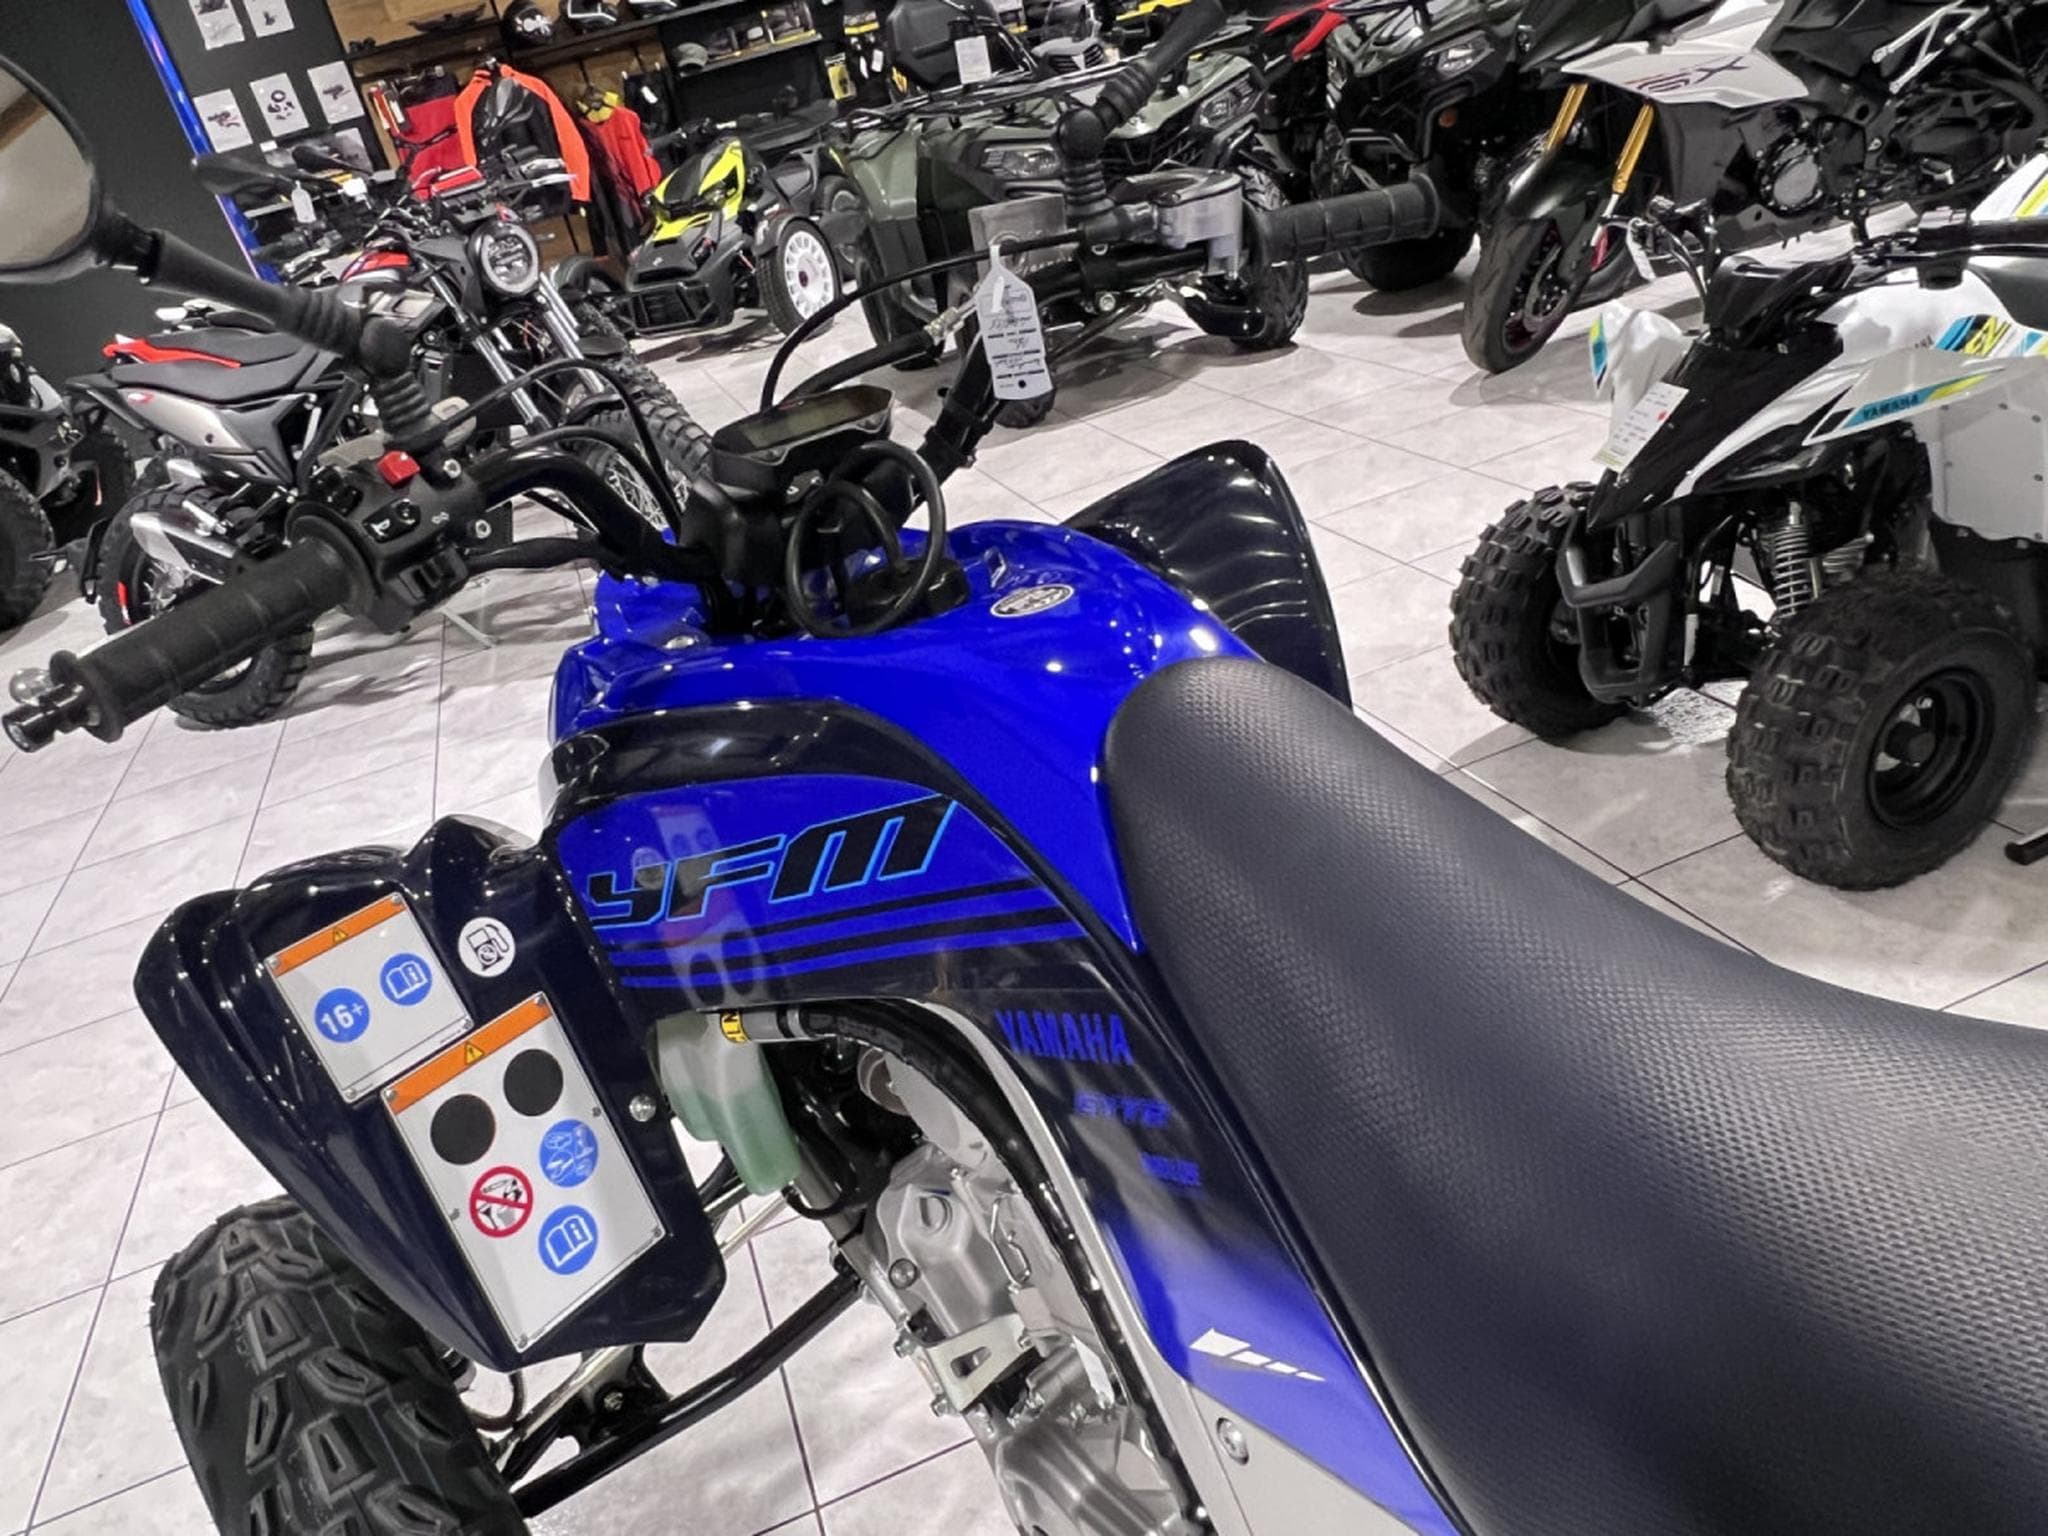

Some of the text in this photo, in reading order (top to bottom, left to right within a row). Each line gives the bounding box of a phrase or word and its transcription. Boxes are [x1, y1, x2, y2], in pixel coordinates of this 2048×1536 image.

[1862, 393, 1920, 420] YAMAHA
[587, 794, 958, 930] YFM
[320, 1002, 365, 1035] 16+
[994, 1009, 1134, 1066] YAMAHA
